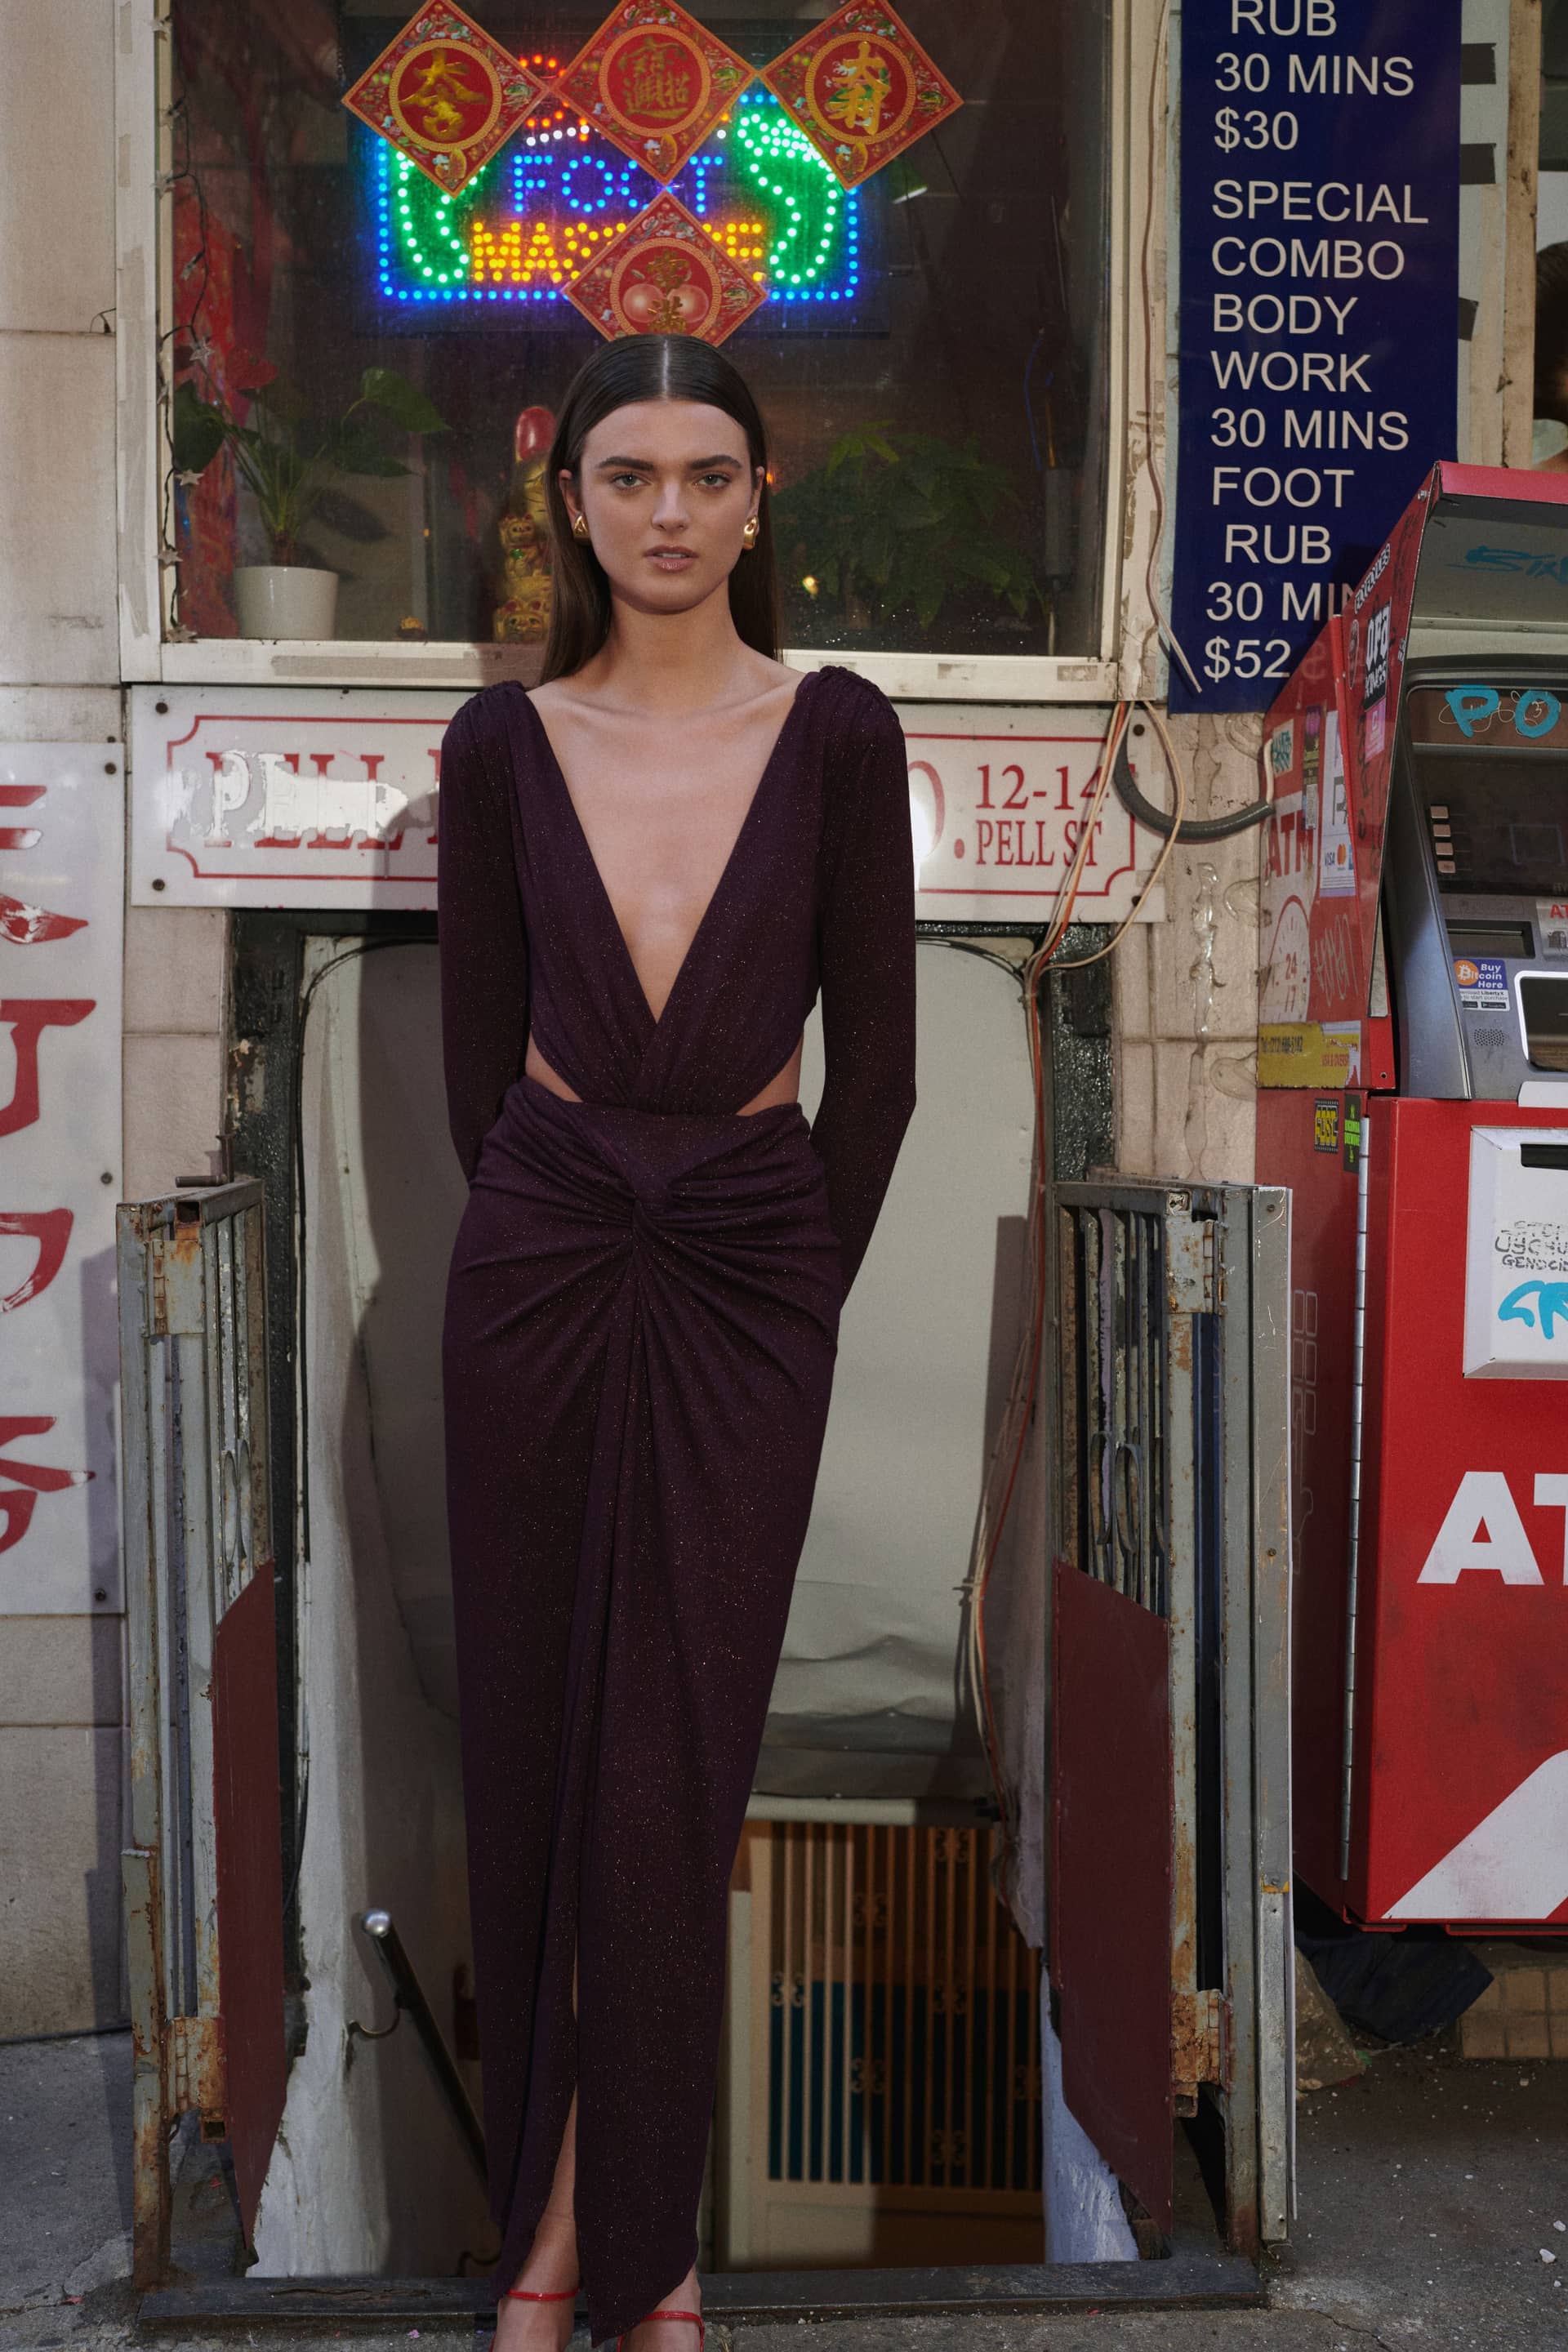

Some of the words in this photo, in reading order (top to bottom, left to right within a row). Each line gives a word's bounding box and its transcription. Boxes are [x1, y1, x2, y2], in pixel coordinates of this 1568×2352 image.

[1232, 0, 1337, 36] RUB
[1214, 52, 1271, 92] 30
[1289, 54, 1414, 96] MINS
[1214, 106, 1299, 153] $30
[1212, 179, 1429, 224] SPECIAL
[474, 222, 763, 281] MASE
[1212, 236, 1405, 280] COMBO
[1214, 293, 1358, 336] BODY
[1210, 350, 1373, 393] WORK
[1210, 408, 1266, 448] 30
[1284, 409, 1409, 451] MINS
[1213, 466, 1355, 508] FOOT
[1225, 523, 1331, 564] RUB
[1206, 581, 1263, 621] 30
[1204, 635, 1291, 684] $52
[976, 764, 1109, 811] 12-14
[976, 819, 1055, 867] PELL
[1063, 819, 1102, 867] ST
[1265, 809, 1314, 878] ATM
[1477, 980, 1503, 988] Here
[1481, 964, 1501, 973] Buy
